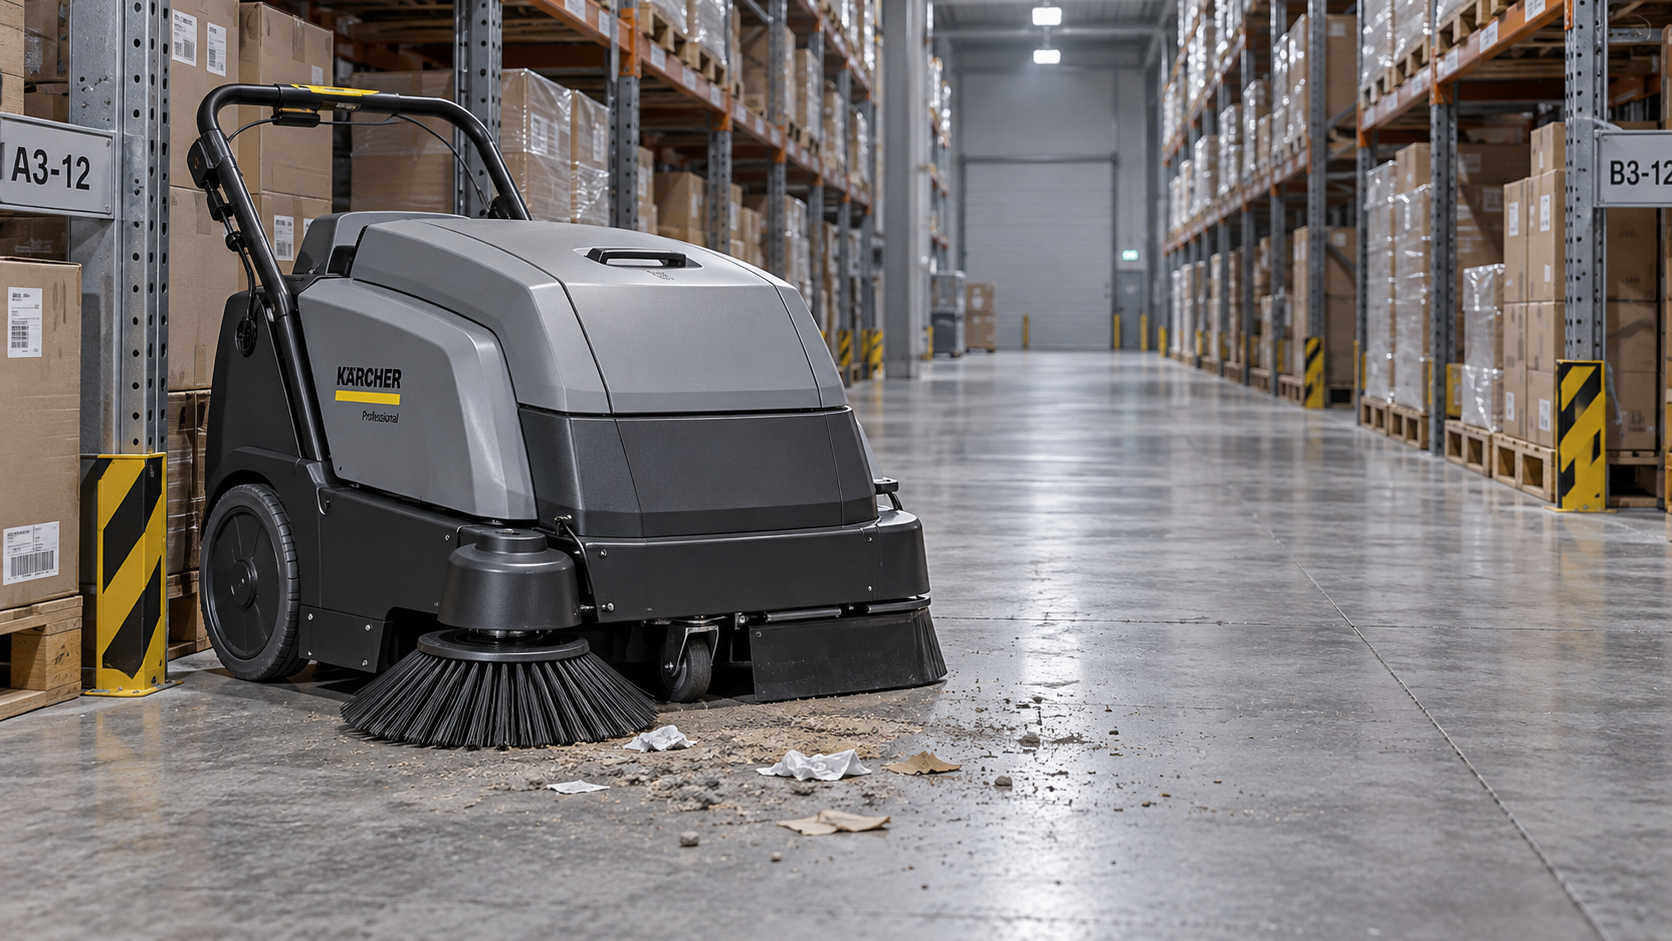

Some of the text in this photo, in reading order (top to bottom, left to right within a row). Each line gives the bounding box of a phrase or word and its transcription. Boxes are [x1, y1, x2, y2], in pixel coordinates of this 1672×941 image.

[11, 146, 90, 191] A3-12
[1610, 160, 1672, 186] B3-12
[336, 366, 402, 389] KÄRCHER
[362, 410, 399, 424] Professional
